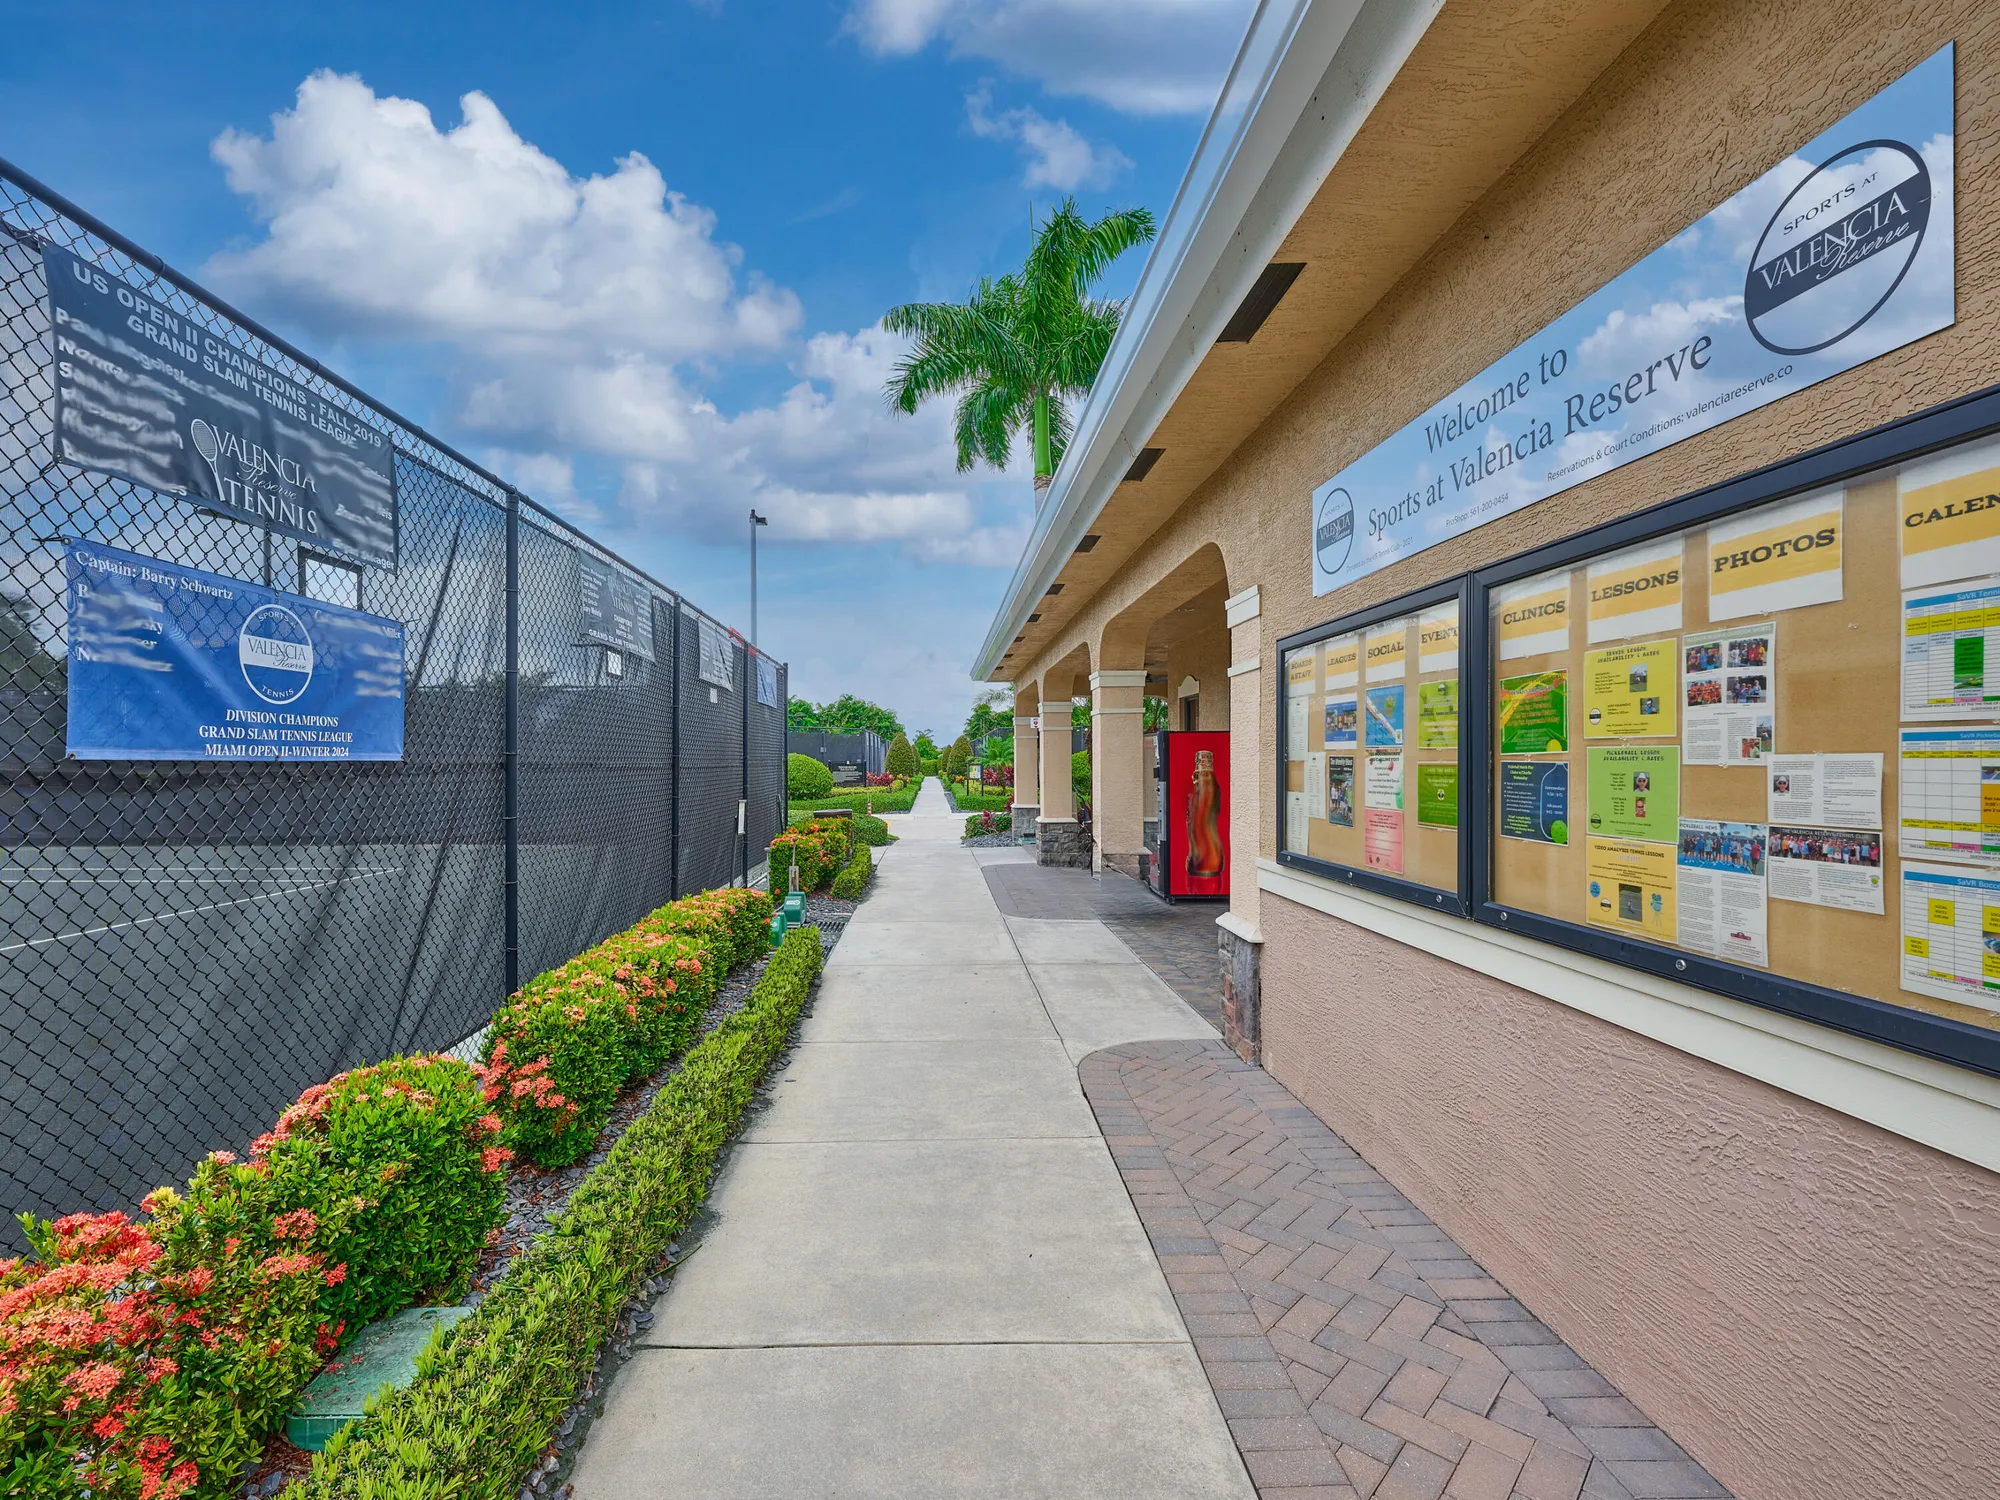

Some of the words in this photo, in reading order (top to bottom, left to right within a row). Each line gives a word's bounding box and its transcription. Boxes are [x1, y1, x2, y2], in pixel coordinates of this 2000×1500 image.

[1783, 183, 1856, 236] SPORTS
[1861, 171, 1878, 188] AT
[1759, 191, 1910, 290] VALENCIA
[1815, 221, 1910, 281] Reserve
[73, 261, 109, 295] US
[117, 288, 179, 335] OPEN
[185, 325, 198, 346] II
[204, 338, 307, 405] CHAMPIONS
[319, 398, 351, 431] FALL
[354, 424, 382, 448] 2019
[126, 314, 198, 363] GRAND
[202, 355, 249, 391] SLAM
[252, 381, 307, 421] TENNIS
[311, 417, 360, 449] LEAGUE
[1425, 371, 1530, 454] Welcome
[1538, 349, 1567, 385] to
[1547, 454, 1594, 482] Reservations
[1595, 449, 1603, 461] &
[1604, 437, 1628, 456] Court
[1630, 413, 1684, 445] Conditions:
[1685, 364, 1793, 419] valenciareserve.co
[1368, 491, 1421, 542] Sports
[1426, 474, 1445, 506] at
[1449, 418, 1554, 493] Valencia
[1564, 335, 1712, 438] Reserve
[211, 424, 318, 493] VALENCIA
[236, 455, 297, 500] Reserve
[223, 477, 318, 534] TENNIS
[1470, 492, 1509, 517] 561-200-0454
[1318, 514, 1351, 541] VALENCIA
[1713, 528, 1836, 574] PHOTOS
[76, 551, 137, 577] Captain:
[141, 567, 178, 590] Barry
[180, 576, 234, 600] Schwartz
[1591, 570, 1679, 603] LESSONS
[1957, 591, 1977, 601] SaVR
[258, 610, 289, 623] SPORTS
[1503, 600, 1566, 626] CLINICS
[588, 629, 608, 641] GRAND
[247, 637, 307, 662] VALENCIA
[272, 650, 307, 671] Reserve
[1327, 652, 1357, 666] LEAGUES
[1367, 641, 1404, 659] SOCIAL
[1291, 659, 1313, 670] BOARDS
[1295, 670, 1312, 680] STAFF
[261, 684, 295, 699] TENNIS
[225, 709, 277, 725] DIVISION
[279, 713, 339, 728] CHAMPIONS
[199, 725, 245, 740] GRAND
[247, 727, 278, 741] SLAM
[280, 729, 317, 742] TENNIS
[318, 731, 353, 743] LEAGUE
[205, 744, 246, 757] MIAMI
[248, 744, 279, 758] OPEN
[280, 745, 330, 758] II-WINTER
[331, 747, 349, 757] 2024
[1607, 846, 1629, 854] ANALYSIS
[1645, 850, 1664, 858] LESSONS
[1957, 878, 1977, 887] SaVR
